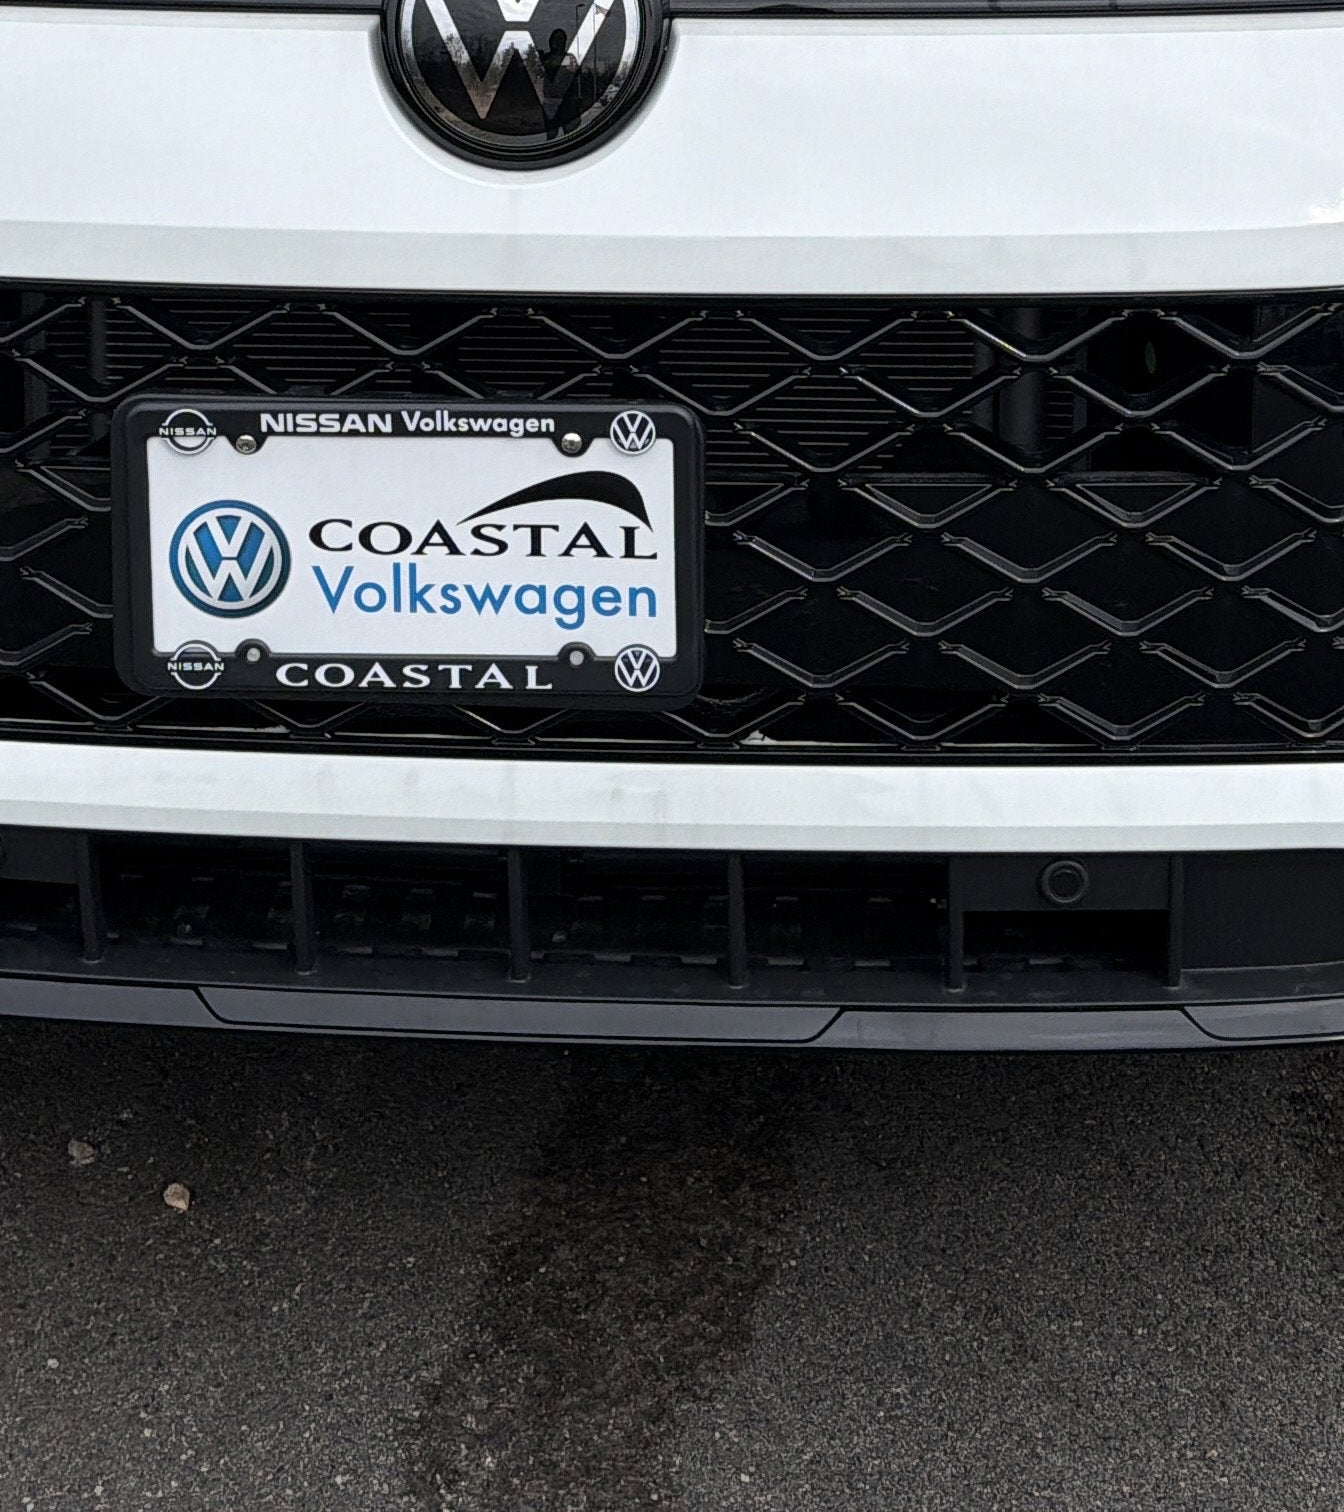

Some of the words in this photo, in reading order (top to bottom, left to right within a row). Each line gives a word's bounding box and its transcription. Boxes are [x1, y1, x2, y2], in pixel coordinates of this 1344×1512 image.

[158, 426, 217, 436] NISSAN
[260, 412, 392, 433] NISSAN
[400, 409, 555, 437] Volkswagen
[308, 519, 658, 560] COASTAL
[312, 561, 657, 630] Volkswagen
[167, 662, 225, 671] NISSAN
[275, 661, 553, 690] COASTAL
